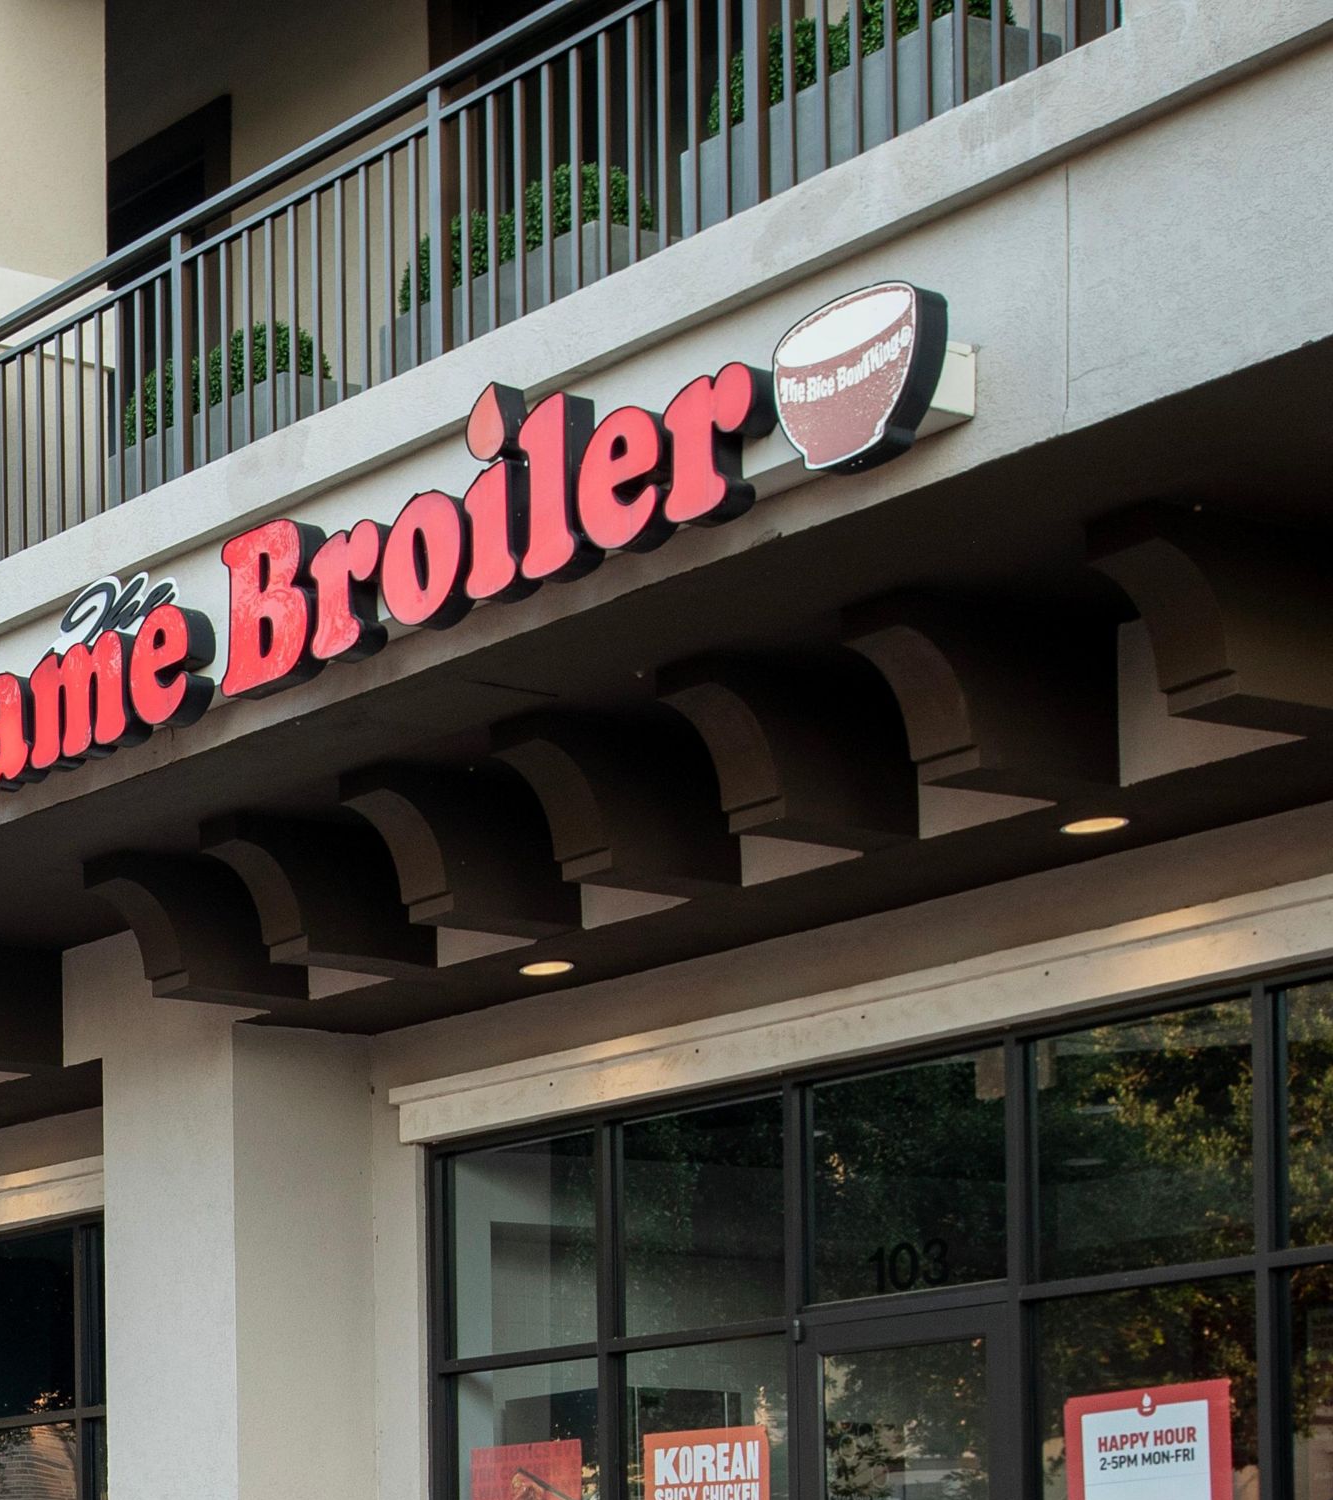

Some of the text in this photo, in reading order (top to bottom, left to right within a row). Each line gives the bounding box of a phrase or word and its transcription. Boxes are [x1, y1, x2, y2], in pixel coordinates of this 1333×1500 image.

[780, 376, 805, 404] The
[806, 373, 835, 402] Rice
[837, 351, 870, 392] Bowl
[220, 362, 756, 699] Broiler
[57, 575, 178, 646] The
[869, 1238, 949, 1292] 103
[654, 1440, 760, 1486] KOREAN
[1098, 1426, 1197, 1453] HAPPY HOUR
[1099, 1448, 1195, 1471] 2-5PM MON-FRI
